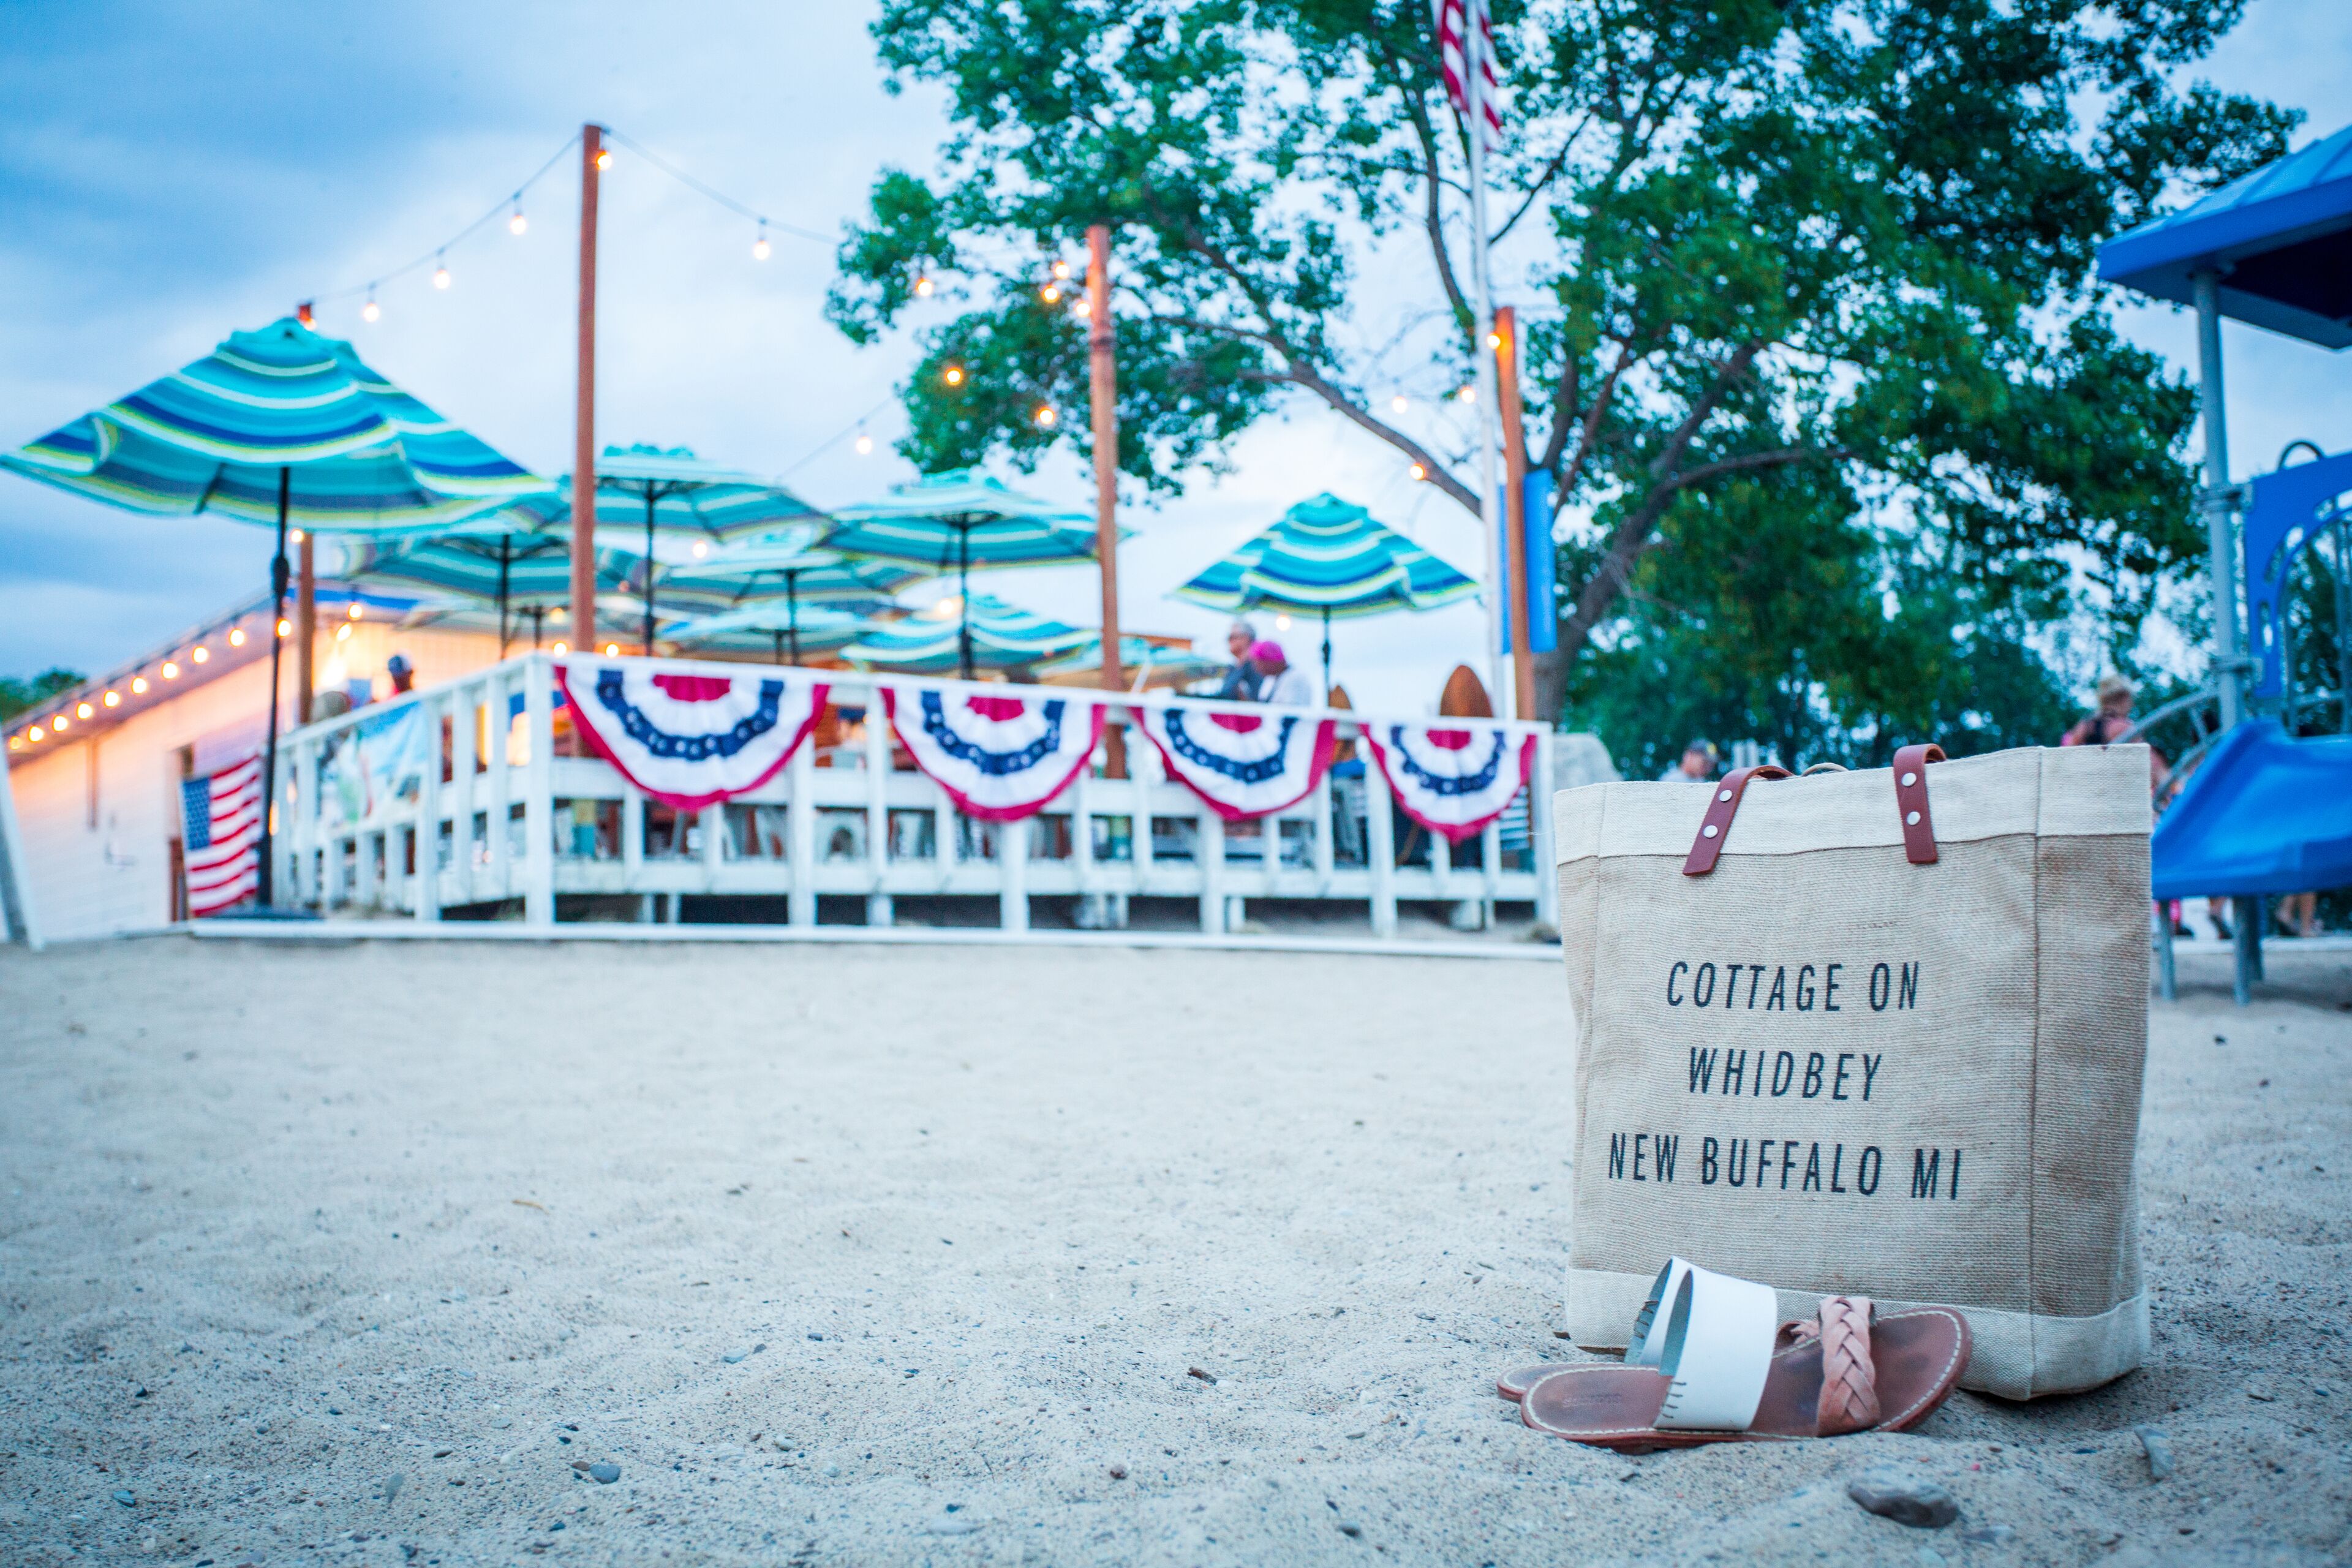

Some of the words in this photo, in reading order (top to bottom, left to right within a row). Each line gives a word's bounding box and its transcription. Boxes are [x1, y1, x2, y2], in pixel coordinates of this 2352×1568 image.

[1667, 960, 1843, 1012] COTTAGE
[1869, 961, 1919, 1012] ON
[1689, 1046, 1882, 1101] WHIDBEY
[1608, 1133, 1679, 1183] NEW
[1701, 1136, 1882, 1197] BUFFALO
[1910, 1148, 1961, 1200] MI
